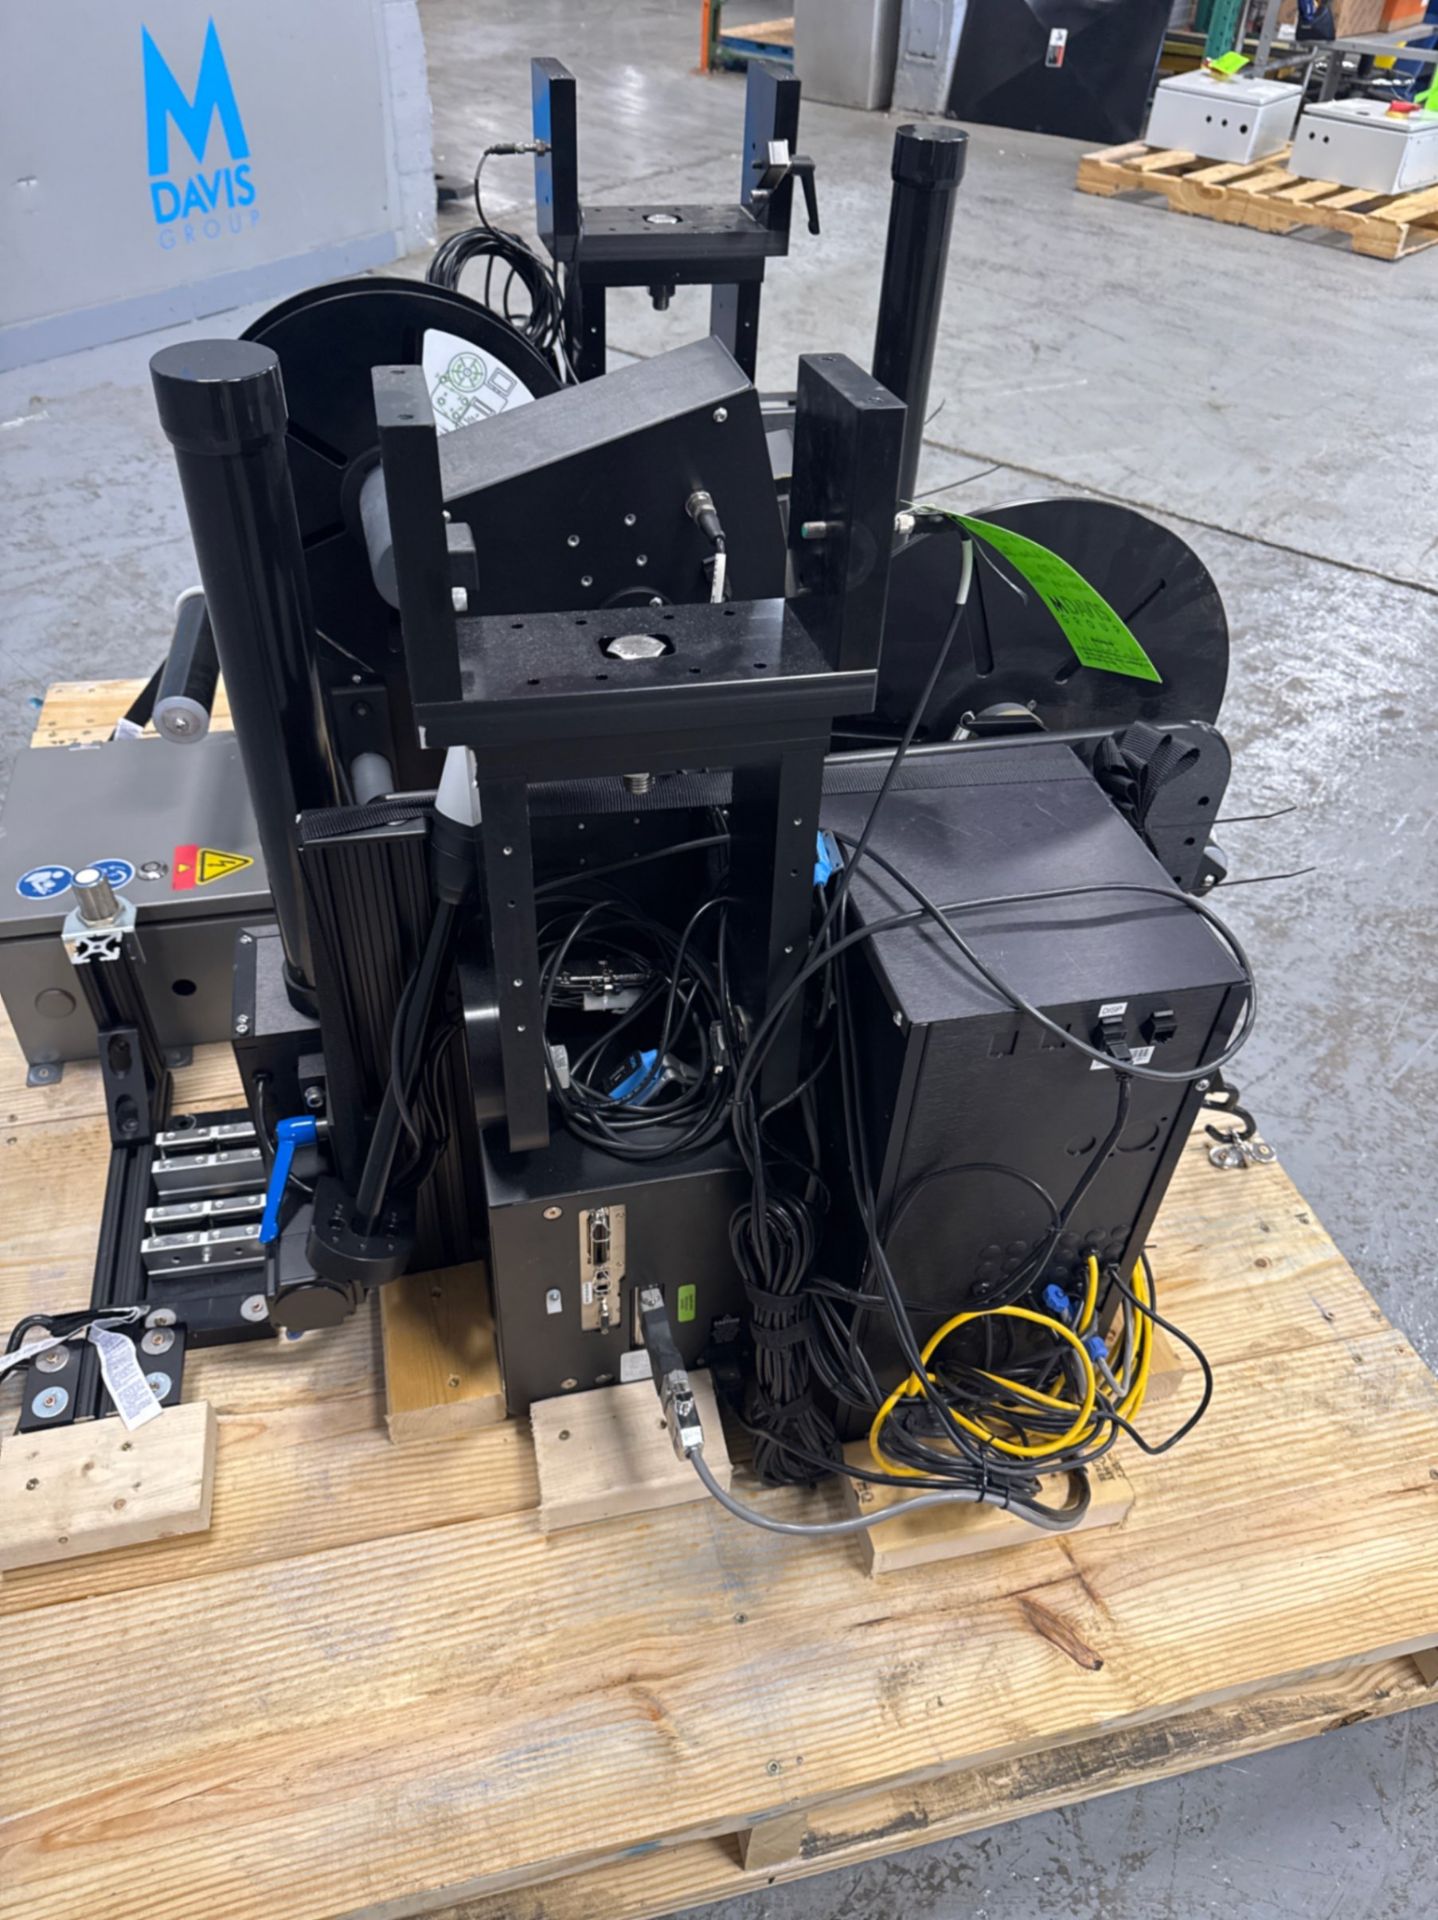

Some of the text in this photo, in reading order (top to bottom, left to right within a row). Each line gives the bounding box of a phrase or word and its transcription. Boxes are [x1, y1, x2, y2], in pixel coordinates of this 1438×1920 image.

[141, 14, 250, 176] M
[150, 163, 256, 225] DAVIS
[158, 208, 260, 251] GROUP
